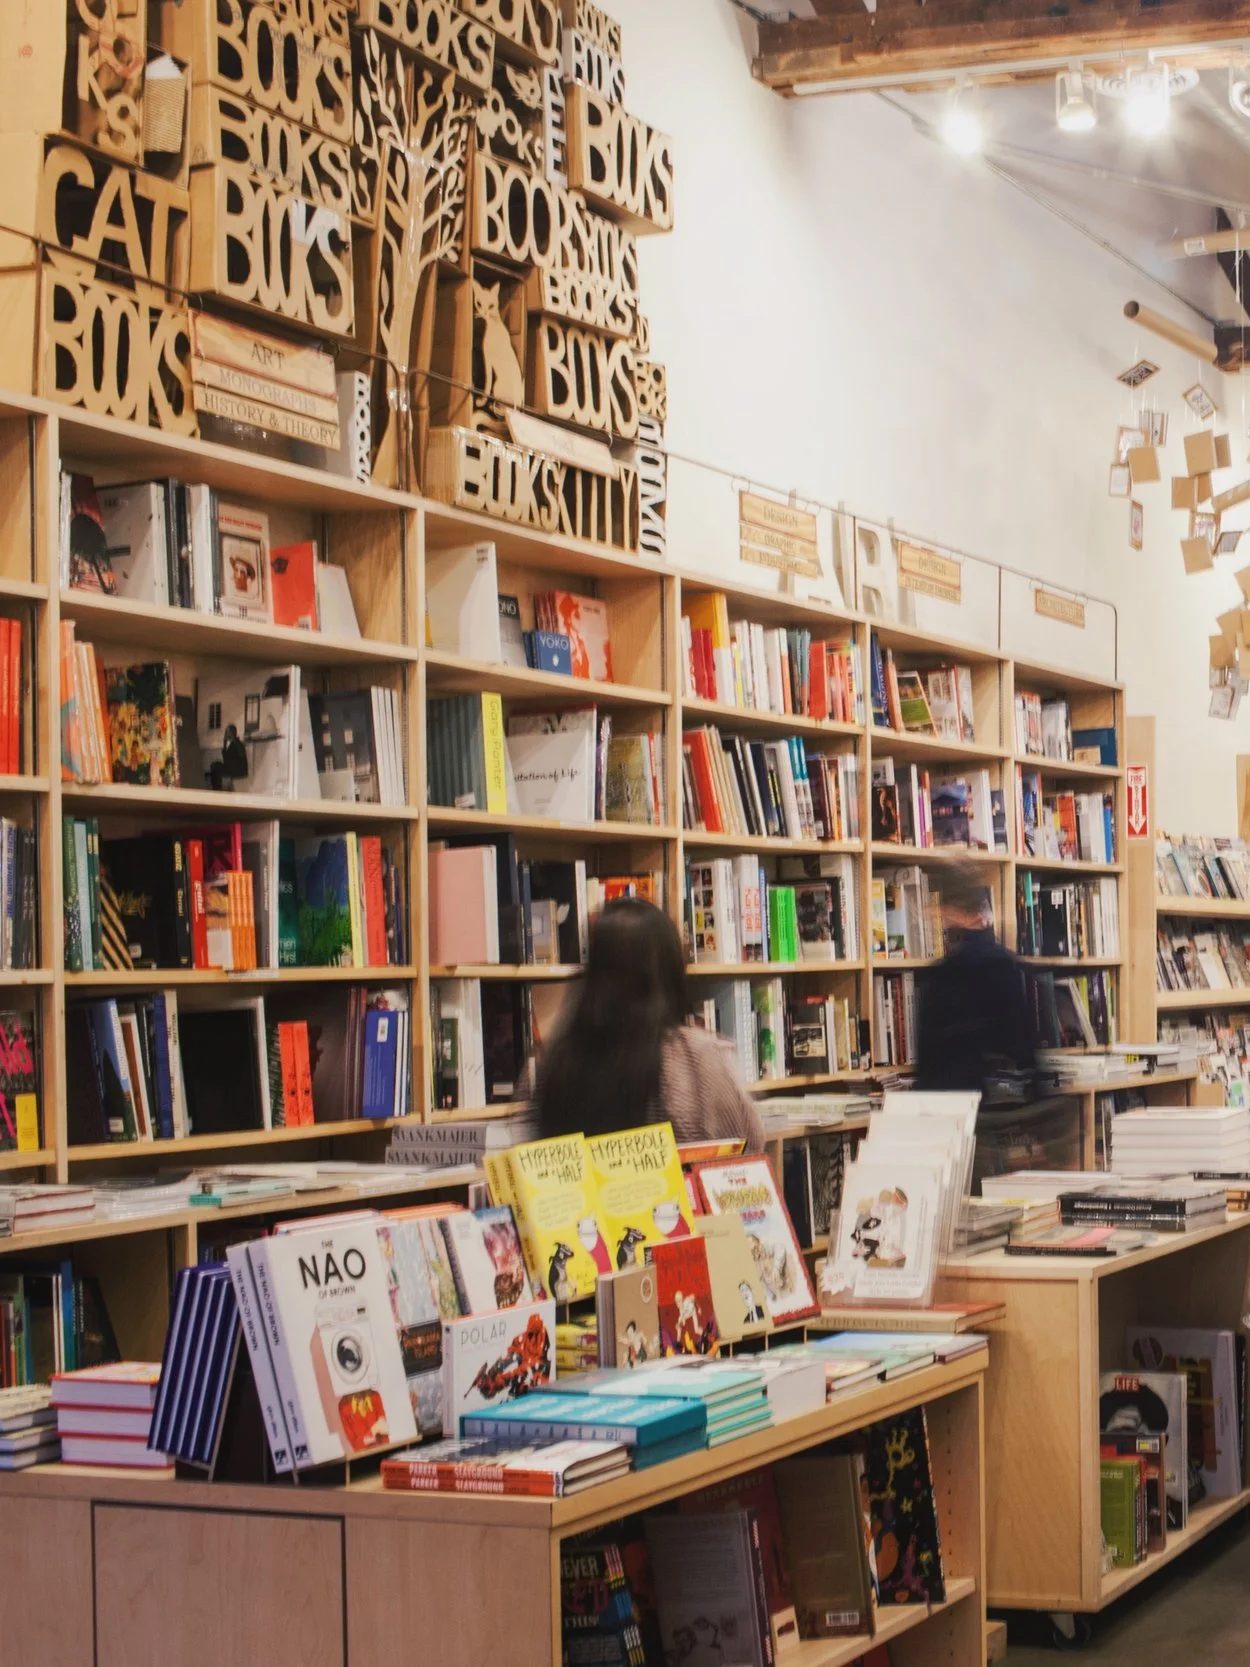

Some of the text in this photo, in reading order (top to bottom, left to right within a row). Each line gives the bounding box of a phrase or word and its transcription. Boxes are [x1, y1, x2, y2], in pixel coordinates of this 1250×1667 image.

[212, 0, 352, 142] BOOKS
[214, 95, 352, 215] BOOKS
[583, 92, 673, 230] BOOKS
[43, 143, 188, 298] CAT
[214, 165, 354, 335] BOOKS
[47, 270, 198, 437] BOOKS
[251, 342, 285, 370] ART
[219, 368, 318, 413] MONOGRAPHS
[543, 318, 638, 438] BOOKS
[204, 393, 338, 446] HISTORY & THEORY
[762, 505, 799, 529] DESIGN
[539, 634, 570, 649] YOKO
[518, 1140, 584, 1173] HYPERBOLE
[590, 1130, 670, 1163] HYPERBOLE
[631, 1150, 670, 1174] HALF
[556, 1162, 584, 1185] HALF
[320, 1239, 334, 1249] THE
[297, 1248, 367, 1289] NAO
[318, 1286, 356, 1300] OF BROWN
[460, 1320, 508, 1346] POLAR
[1115, 1376, 1139, 1392] LIFE
[408, 1463, 504, 1480] PARKER SLAYGROUND
[410, 1476, 505, 1493] PARKER SLAYGROUND
